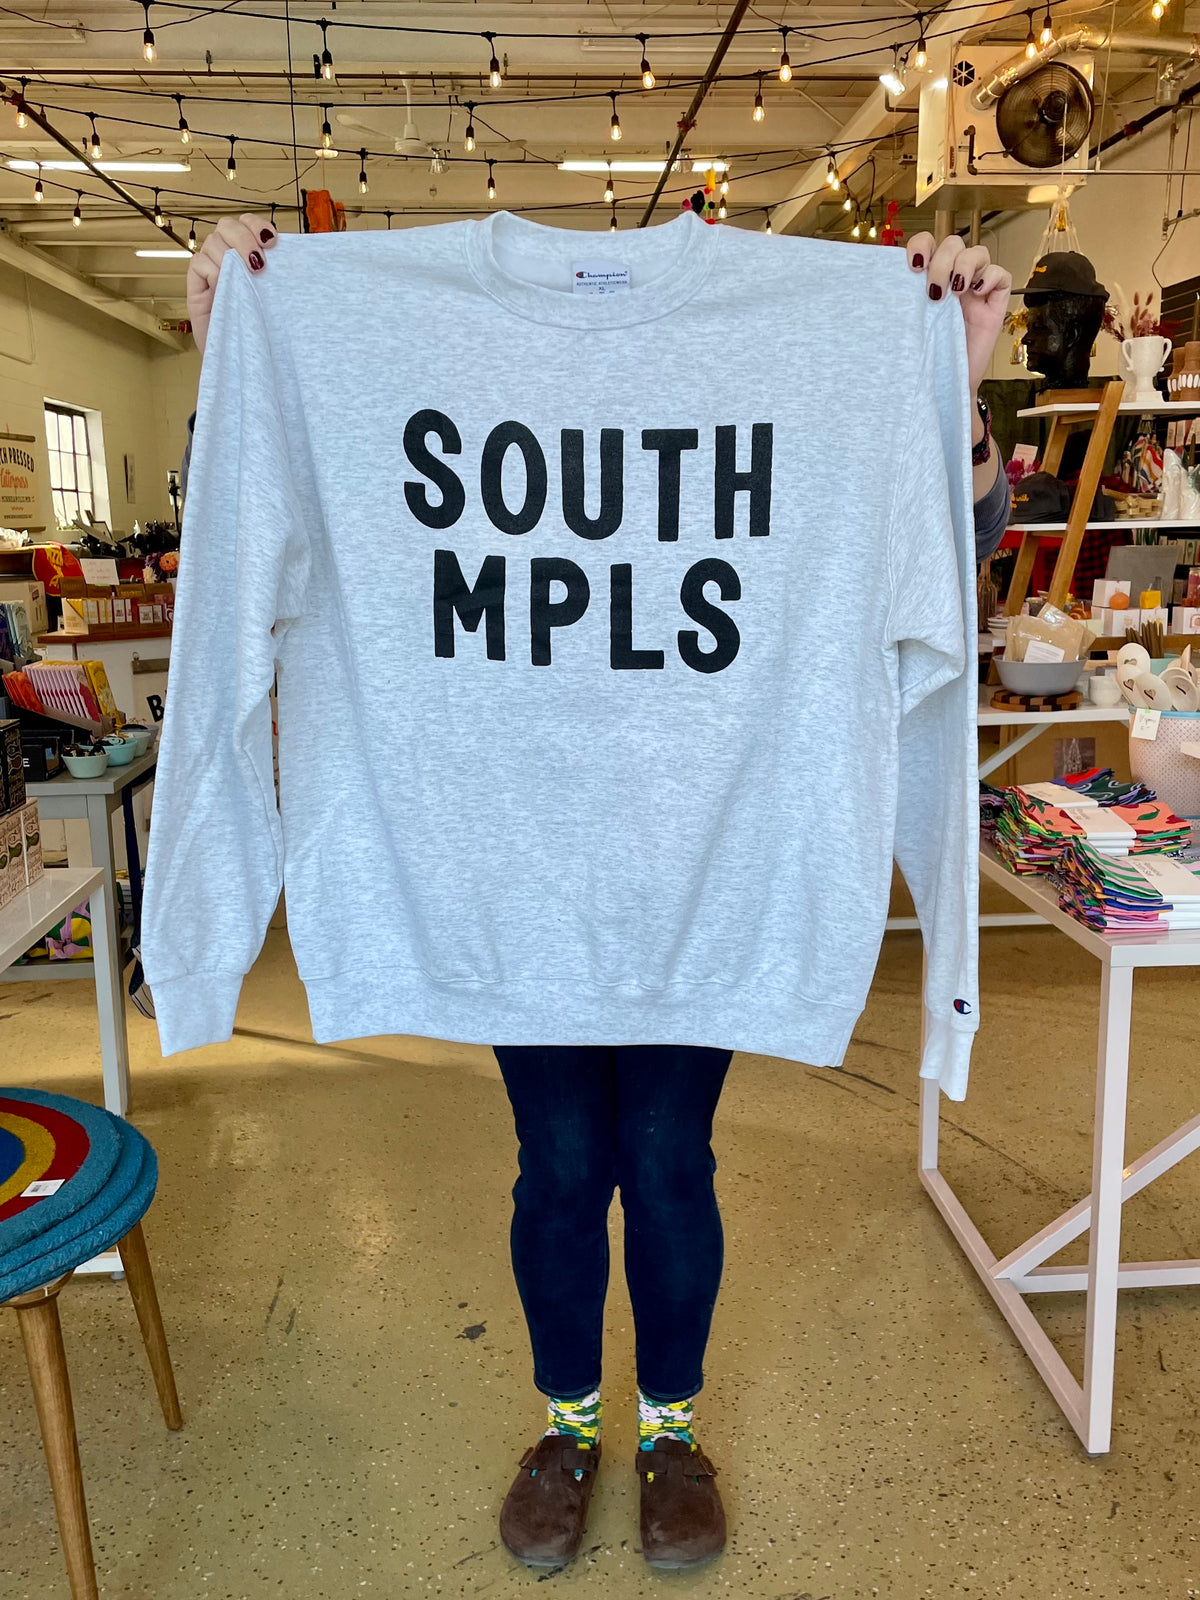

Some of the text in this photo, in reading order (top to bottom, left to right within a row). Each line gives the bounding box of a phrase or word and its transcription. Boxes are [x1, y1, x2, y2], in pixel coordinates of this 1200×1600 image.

[8, 446, 35, 473] PRESSED
[402, 408, 774, 542] SOUTH
[433, 549, 742, 674] MPLS
